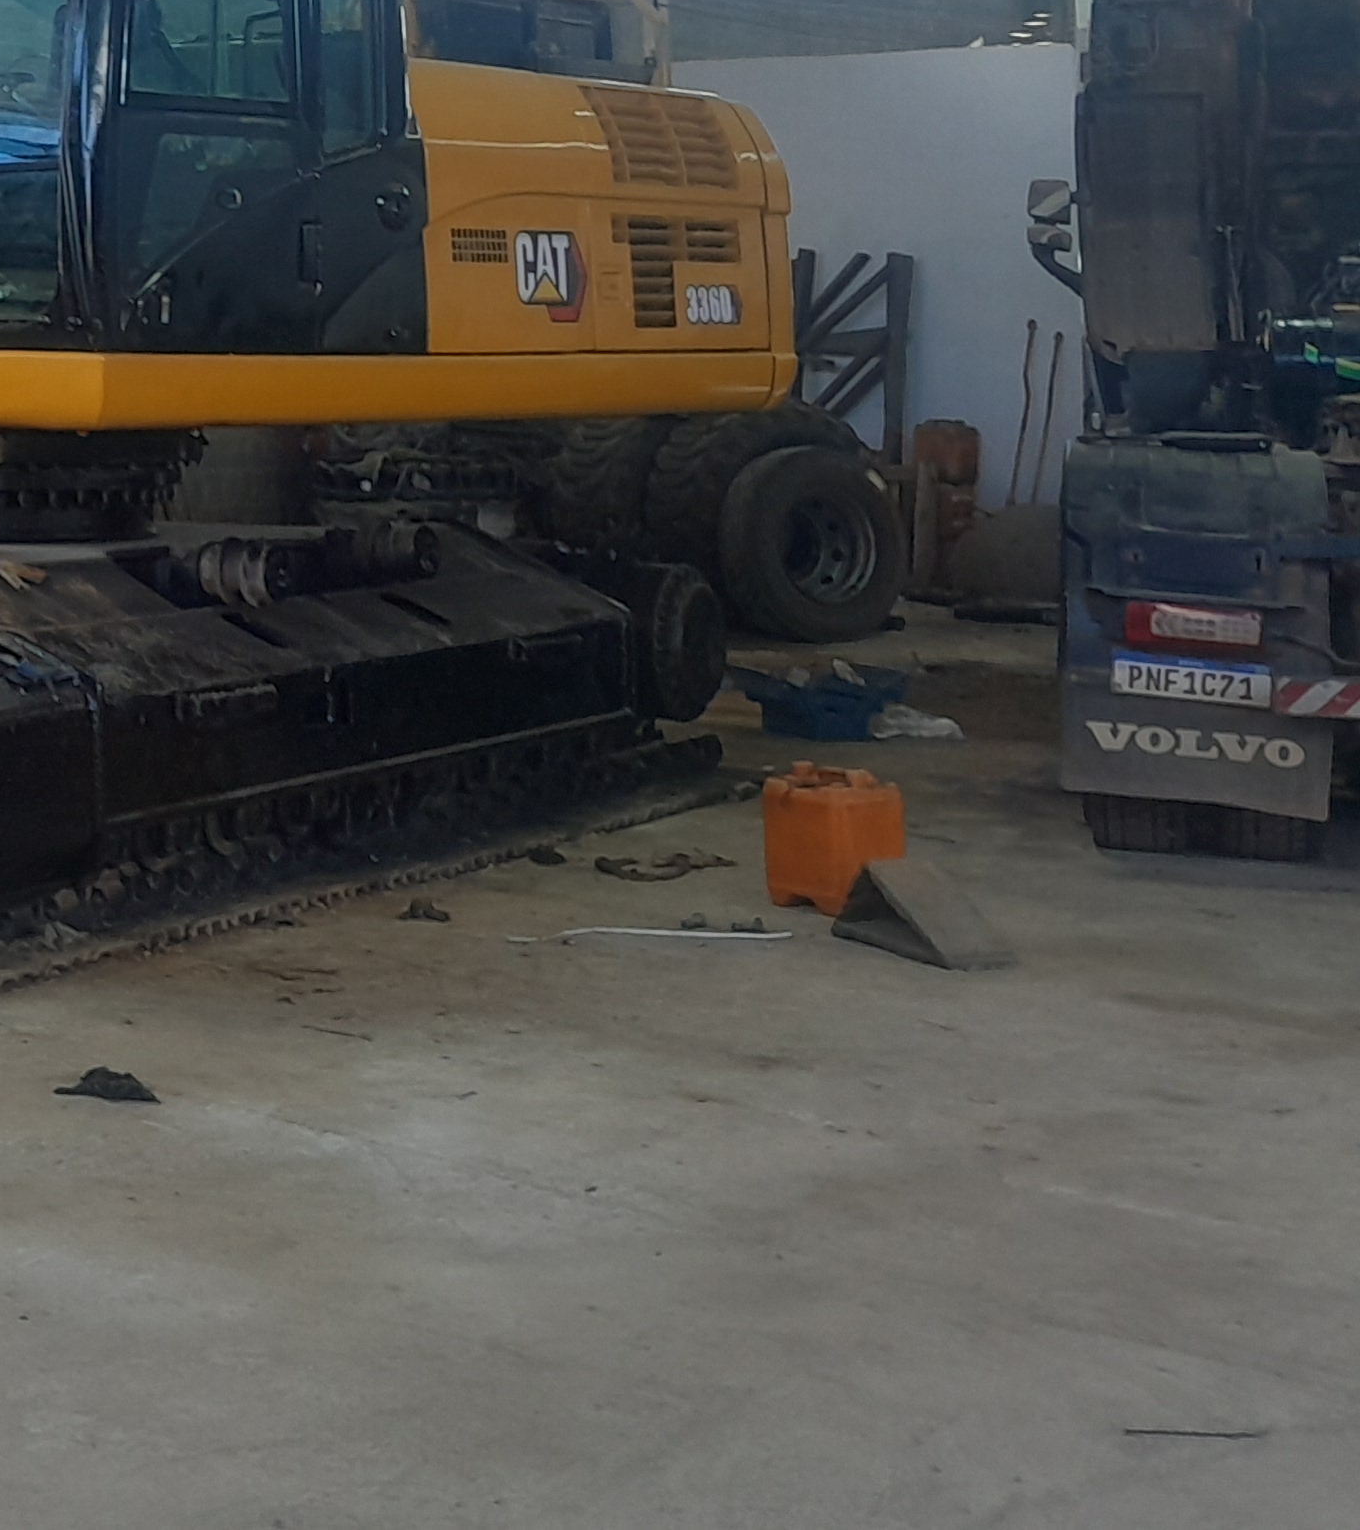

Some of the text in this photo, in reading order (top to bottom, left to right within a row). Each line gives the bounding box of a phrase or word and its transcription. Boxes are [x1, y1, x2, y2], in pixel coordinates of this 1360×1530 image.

[516, 232, 570, 304] CAT
[1128, 665, 1254, 700] PNF1C71
[1086, 721, 1306, 768] VOLVO
